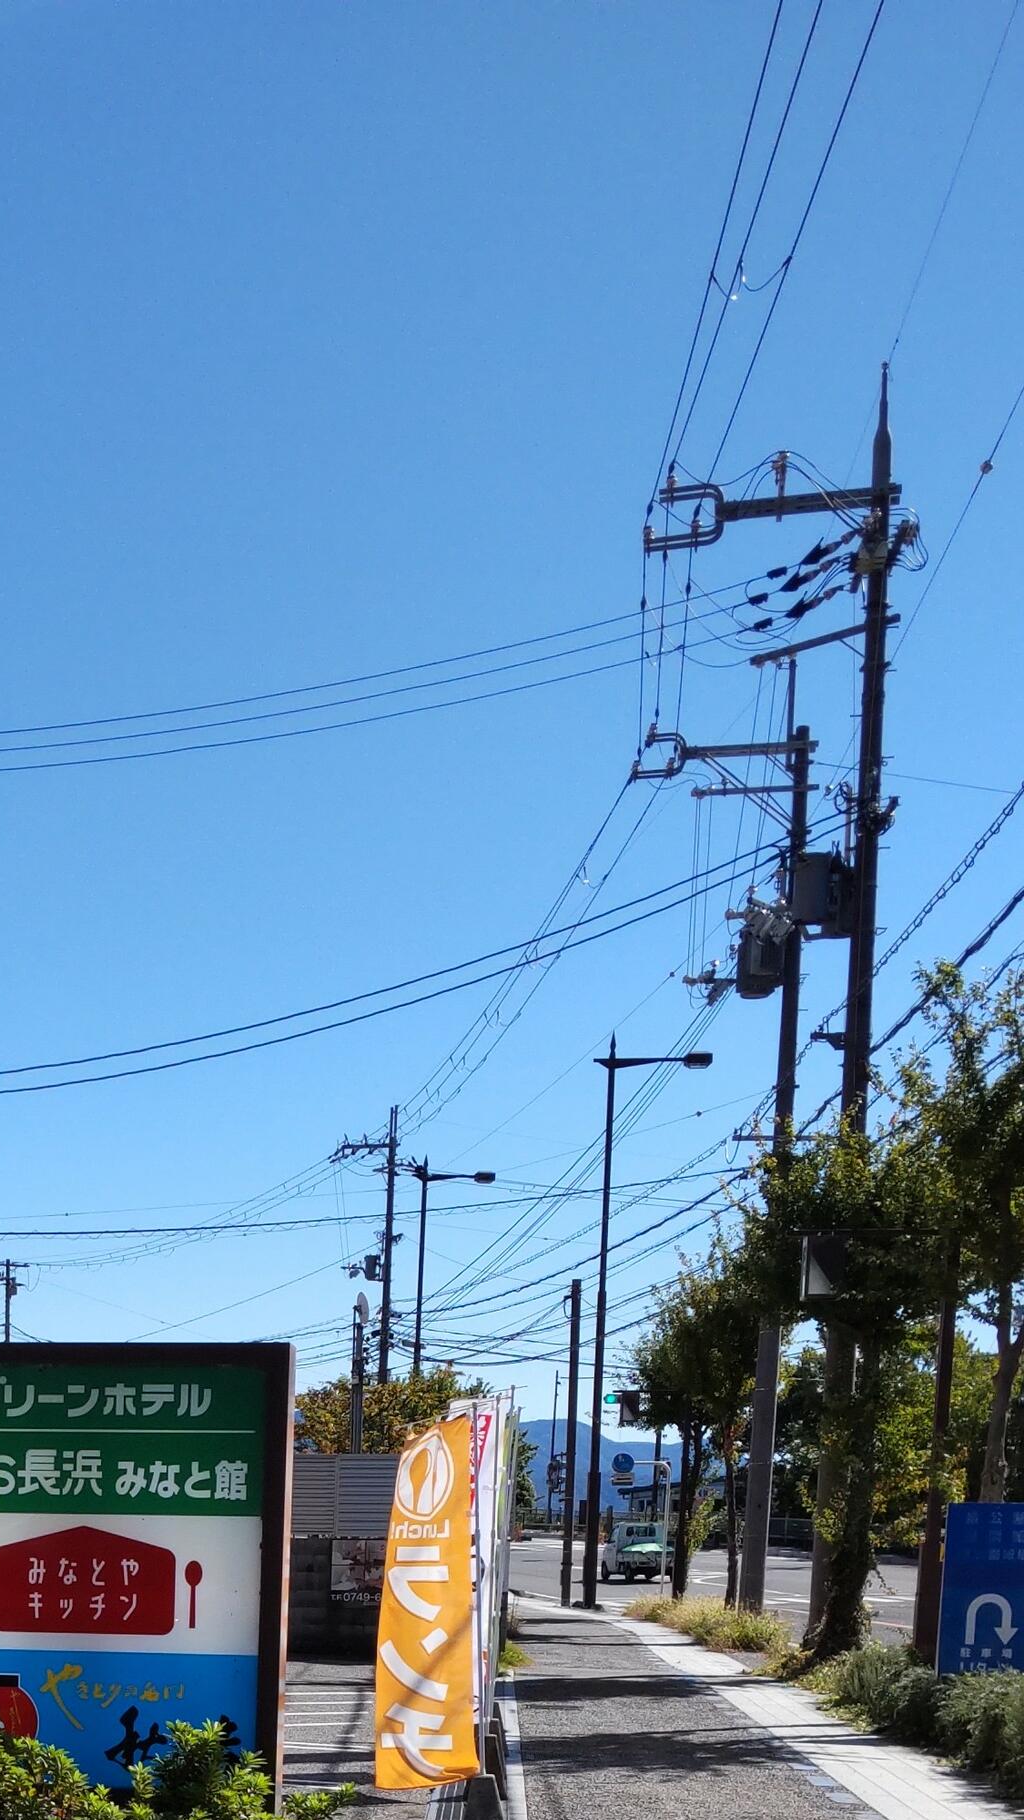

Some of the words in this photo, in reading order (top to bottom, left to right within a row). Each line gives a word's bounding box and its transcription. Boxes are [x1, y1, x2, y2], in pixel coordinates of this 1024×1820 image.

[115, 1460, 249, 1501] みなと館
[27, 1557, 140, 1586] みなとや
[28, 1592, 138, 1621] キッチン
